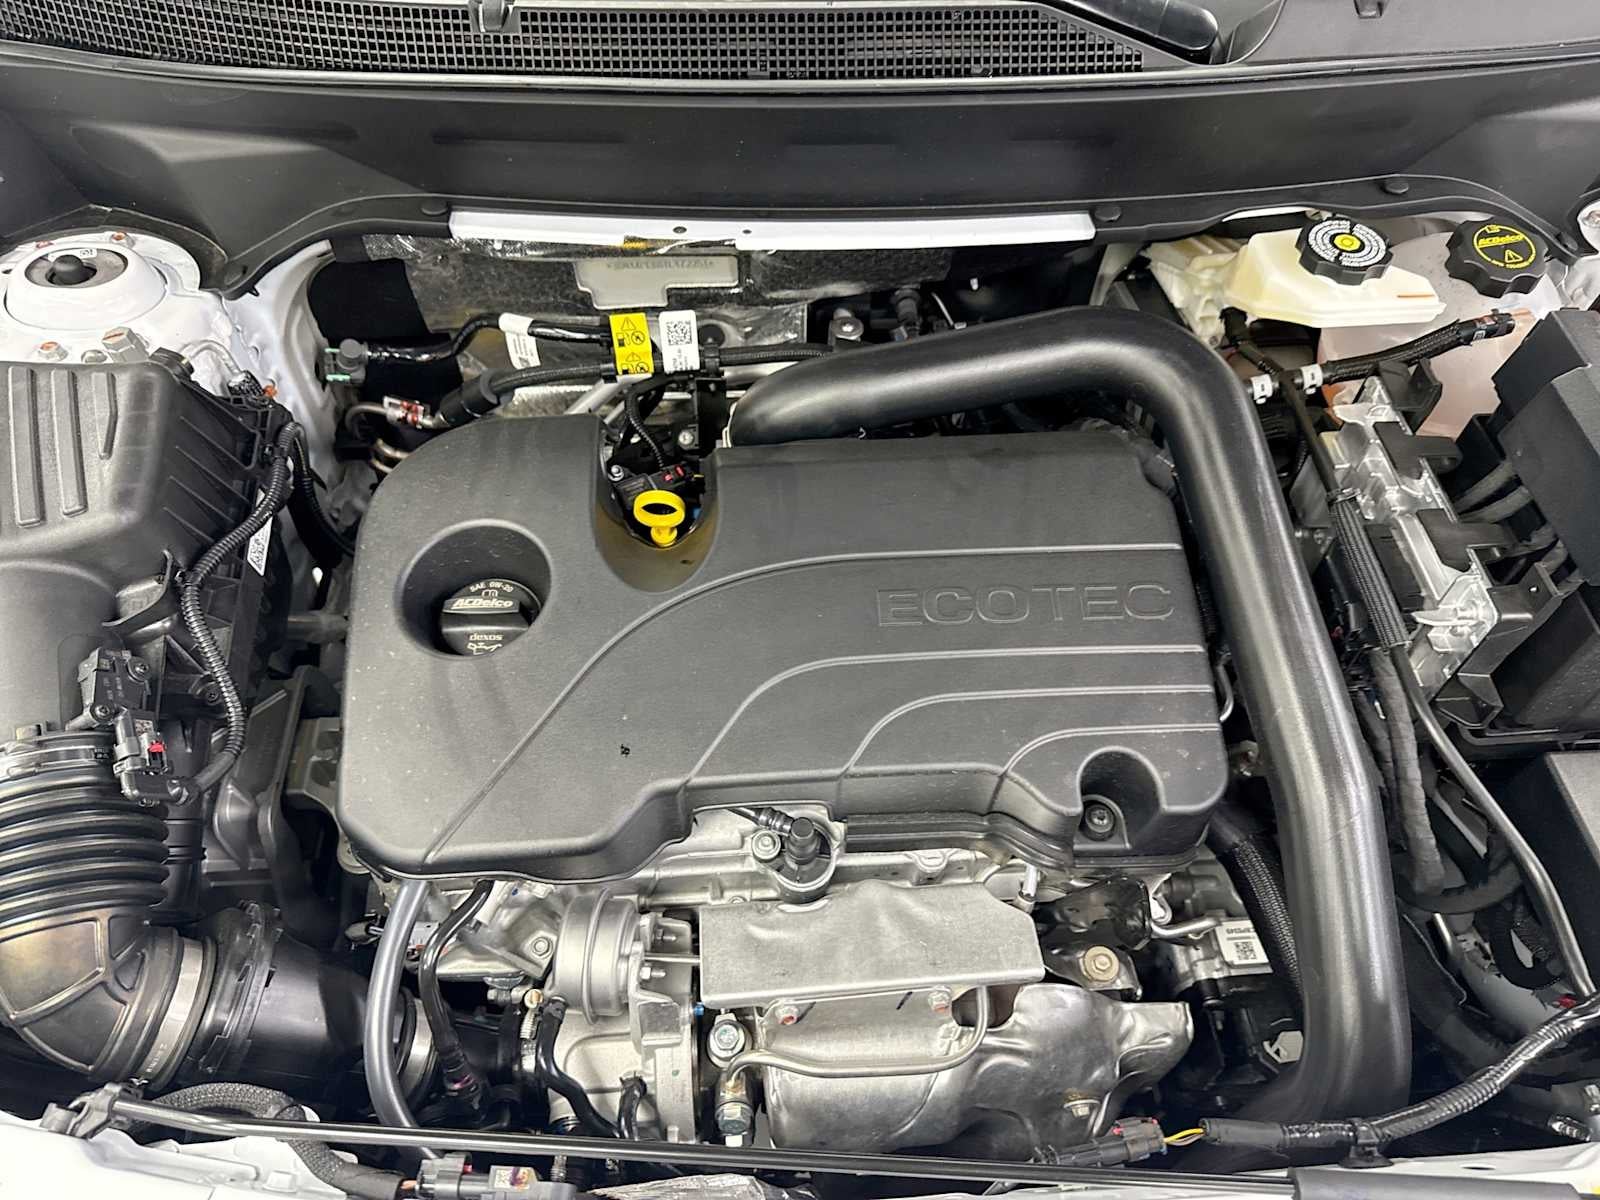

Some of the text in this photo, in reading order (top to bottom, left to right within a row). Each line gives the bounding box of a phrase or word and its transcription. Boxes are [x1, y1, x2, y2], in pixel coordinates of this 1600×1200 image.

[469, 581, 514, 593] SAE 0W-20
[450, 599, 514, 610] ACDelco
[877, 581, 1174, 627] ECOTEC
[469, 632, 504, 641] dexos
